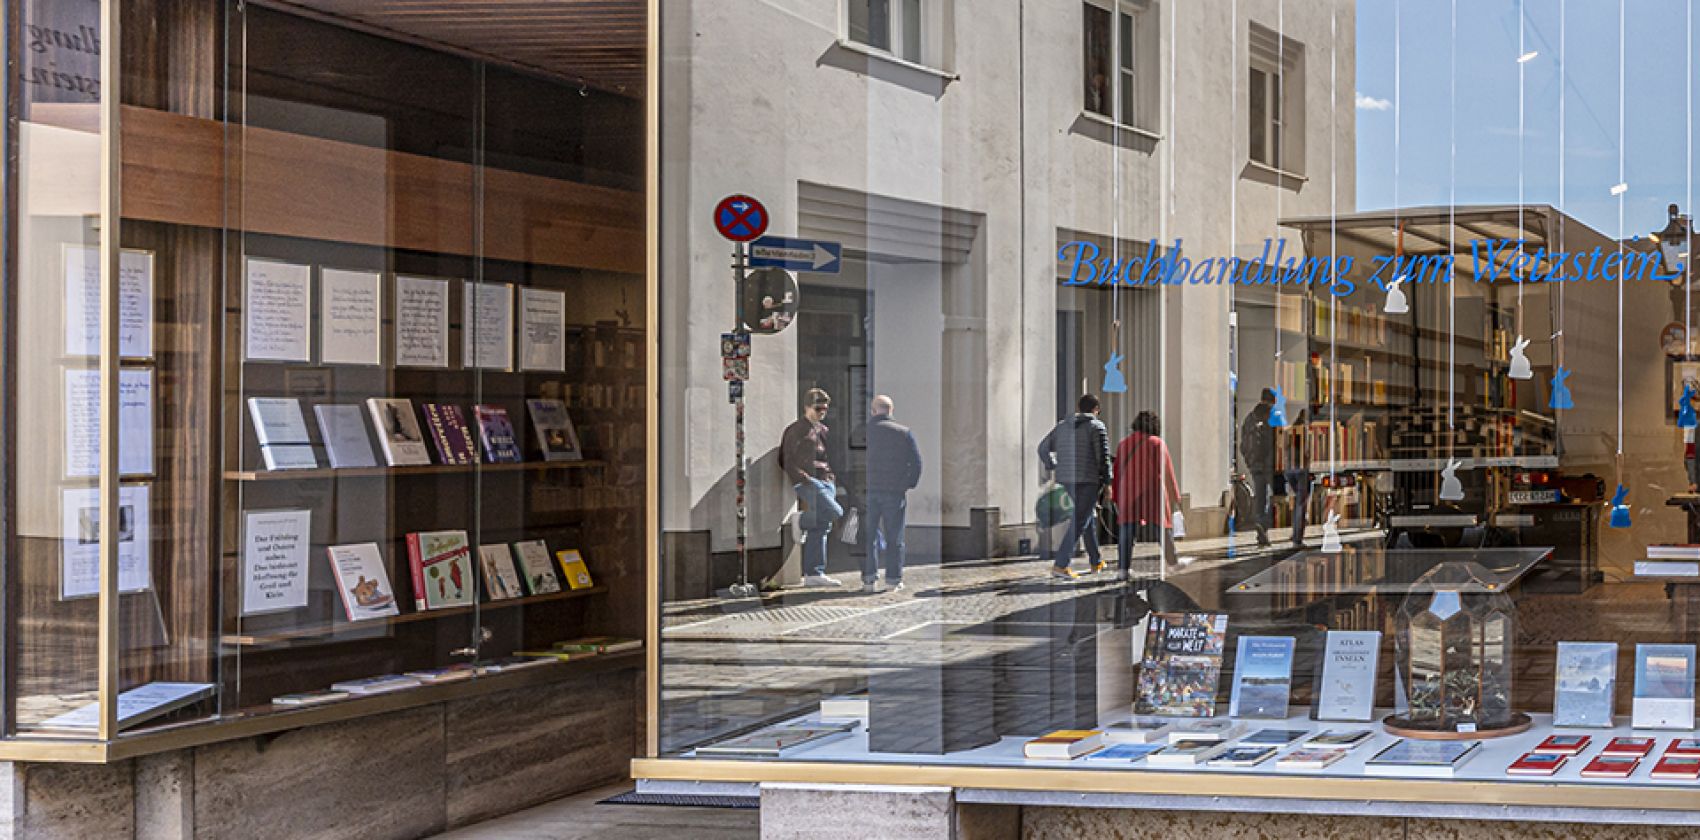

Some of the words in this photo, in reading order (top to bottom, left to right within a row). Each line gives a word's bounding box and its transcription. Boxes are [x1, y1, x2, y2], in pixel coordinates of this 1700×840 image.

[1057, 238, 1354, 296] Buchhandlung
[1368, 253, 1454, 292] zum
[1468, 234, 1683, 282] Wetzstein
